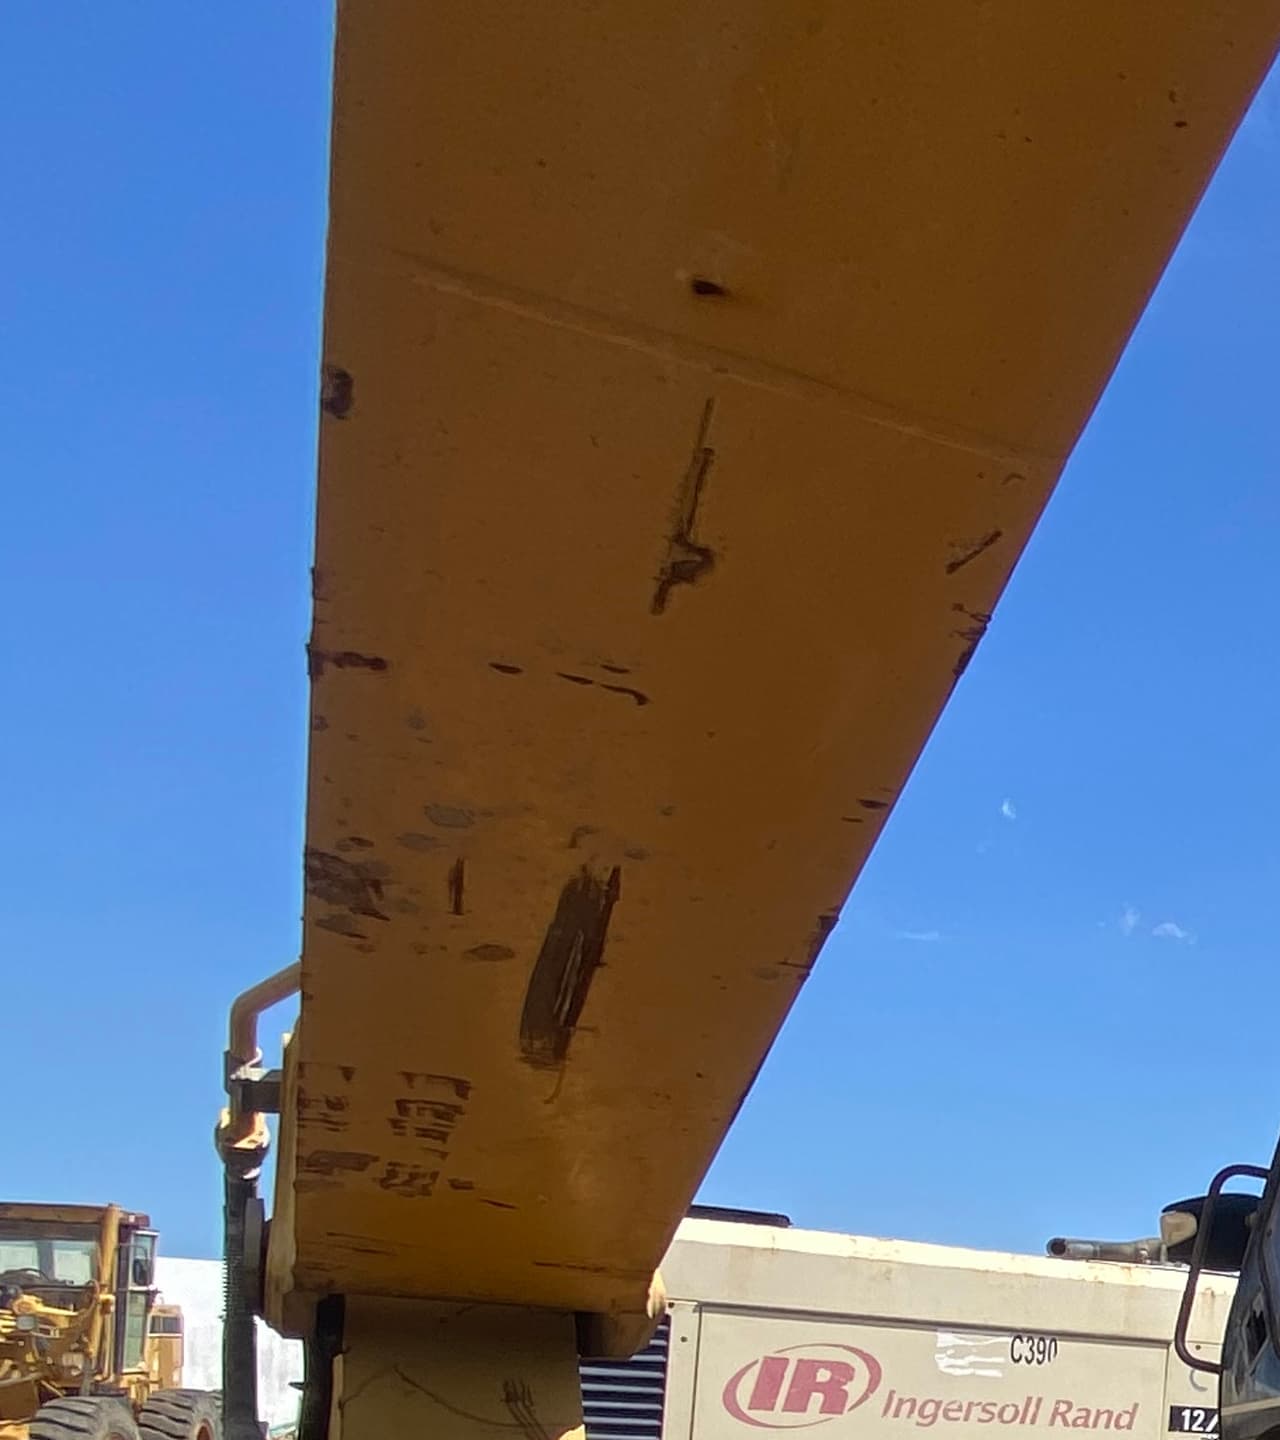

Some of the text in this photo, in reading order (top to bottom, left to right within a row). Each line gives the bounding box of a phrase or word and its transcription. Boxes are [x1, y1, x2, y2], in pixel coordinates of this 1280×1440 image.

[747, 1355, 856, 1415] IR
[880, 1390, 1140, 1431] Ingersoll Rand
